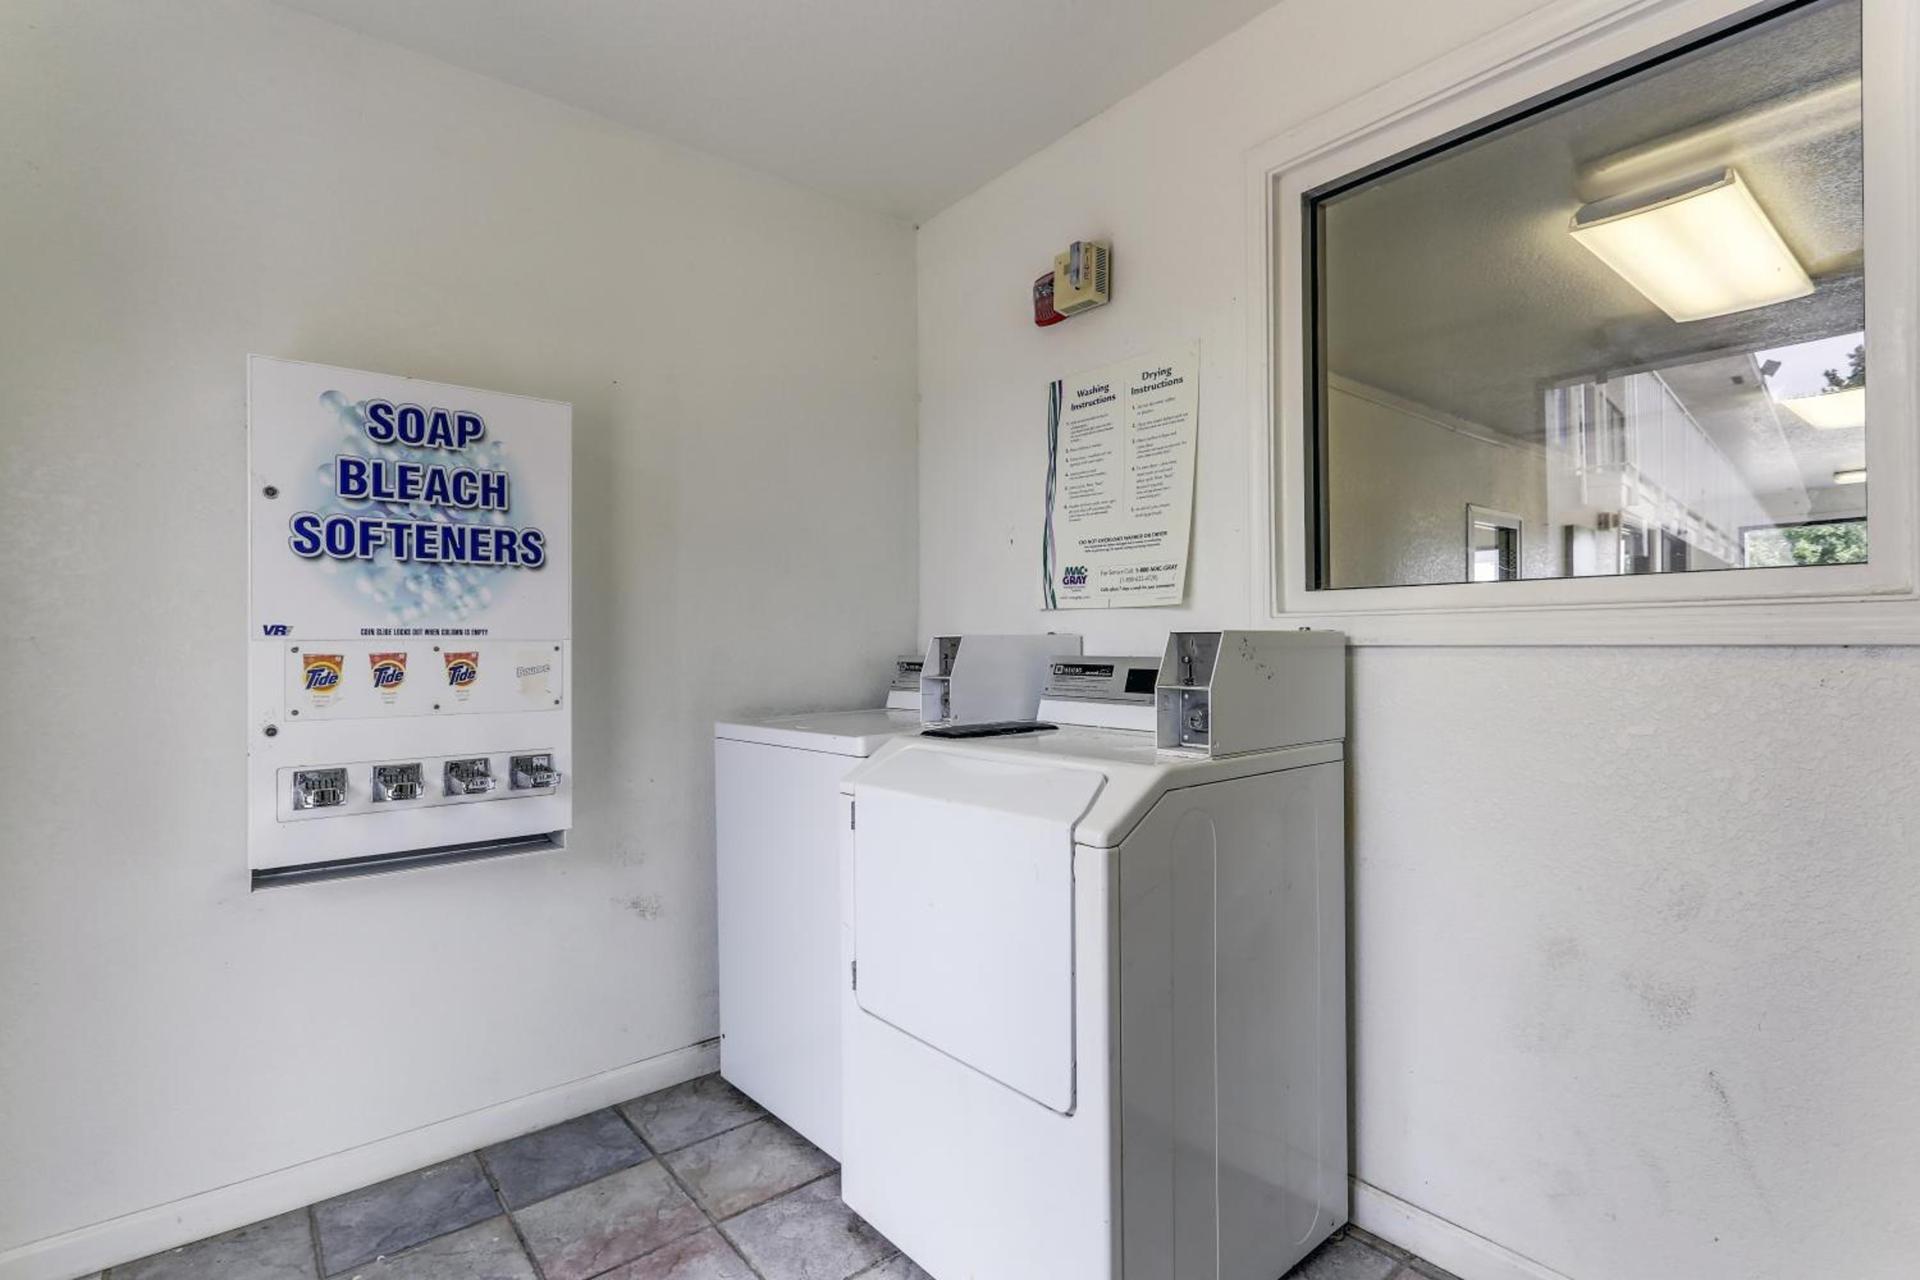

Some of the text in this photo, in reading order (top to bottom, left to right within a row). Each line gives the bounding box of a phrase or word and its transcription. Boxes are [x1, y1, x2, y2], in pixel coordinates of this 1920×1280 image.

[1142, 367, 1172, 381] Drying
[1076, 384, 1109, 398] Washing
[1131, 377, 1183, 395] Instructions
[1070, 394, 1116, 411] Instructions
[365, 399, 486, 451] SOAP
[335, 454, 511, 512] BLEACH
[289, 511, 547, 569] SOFTENERS
[1062, 575, 1088, 585] GRAY
[360, 627, 375, 636] COIN
[376, 627, 392, 636] SLIDE
[393, 627, 411, 636] LOCKS
[424, 627, 440, 636] WHEN
[464, 627, 470, 636] IS
[471, 627, 488, 636] EMPTY
[306, 668, 339, 690] Tide
[374, 666, 404, 688] Tide
[448, 665, 476, 686] Tide
